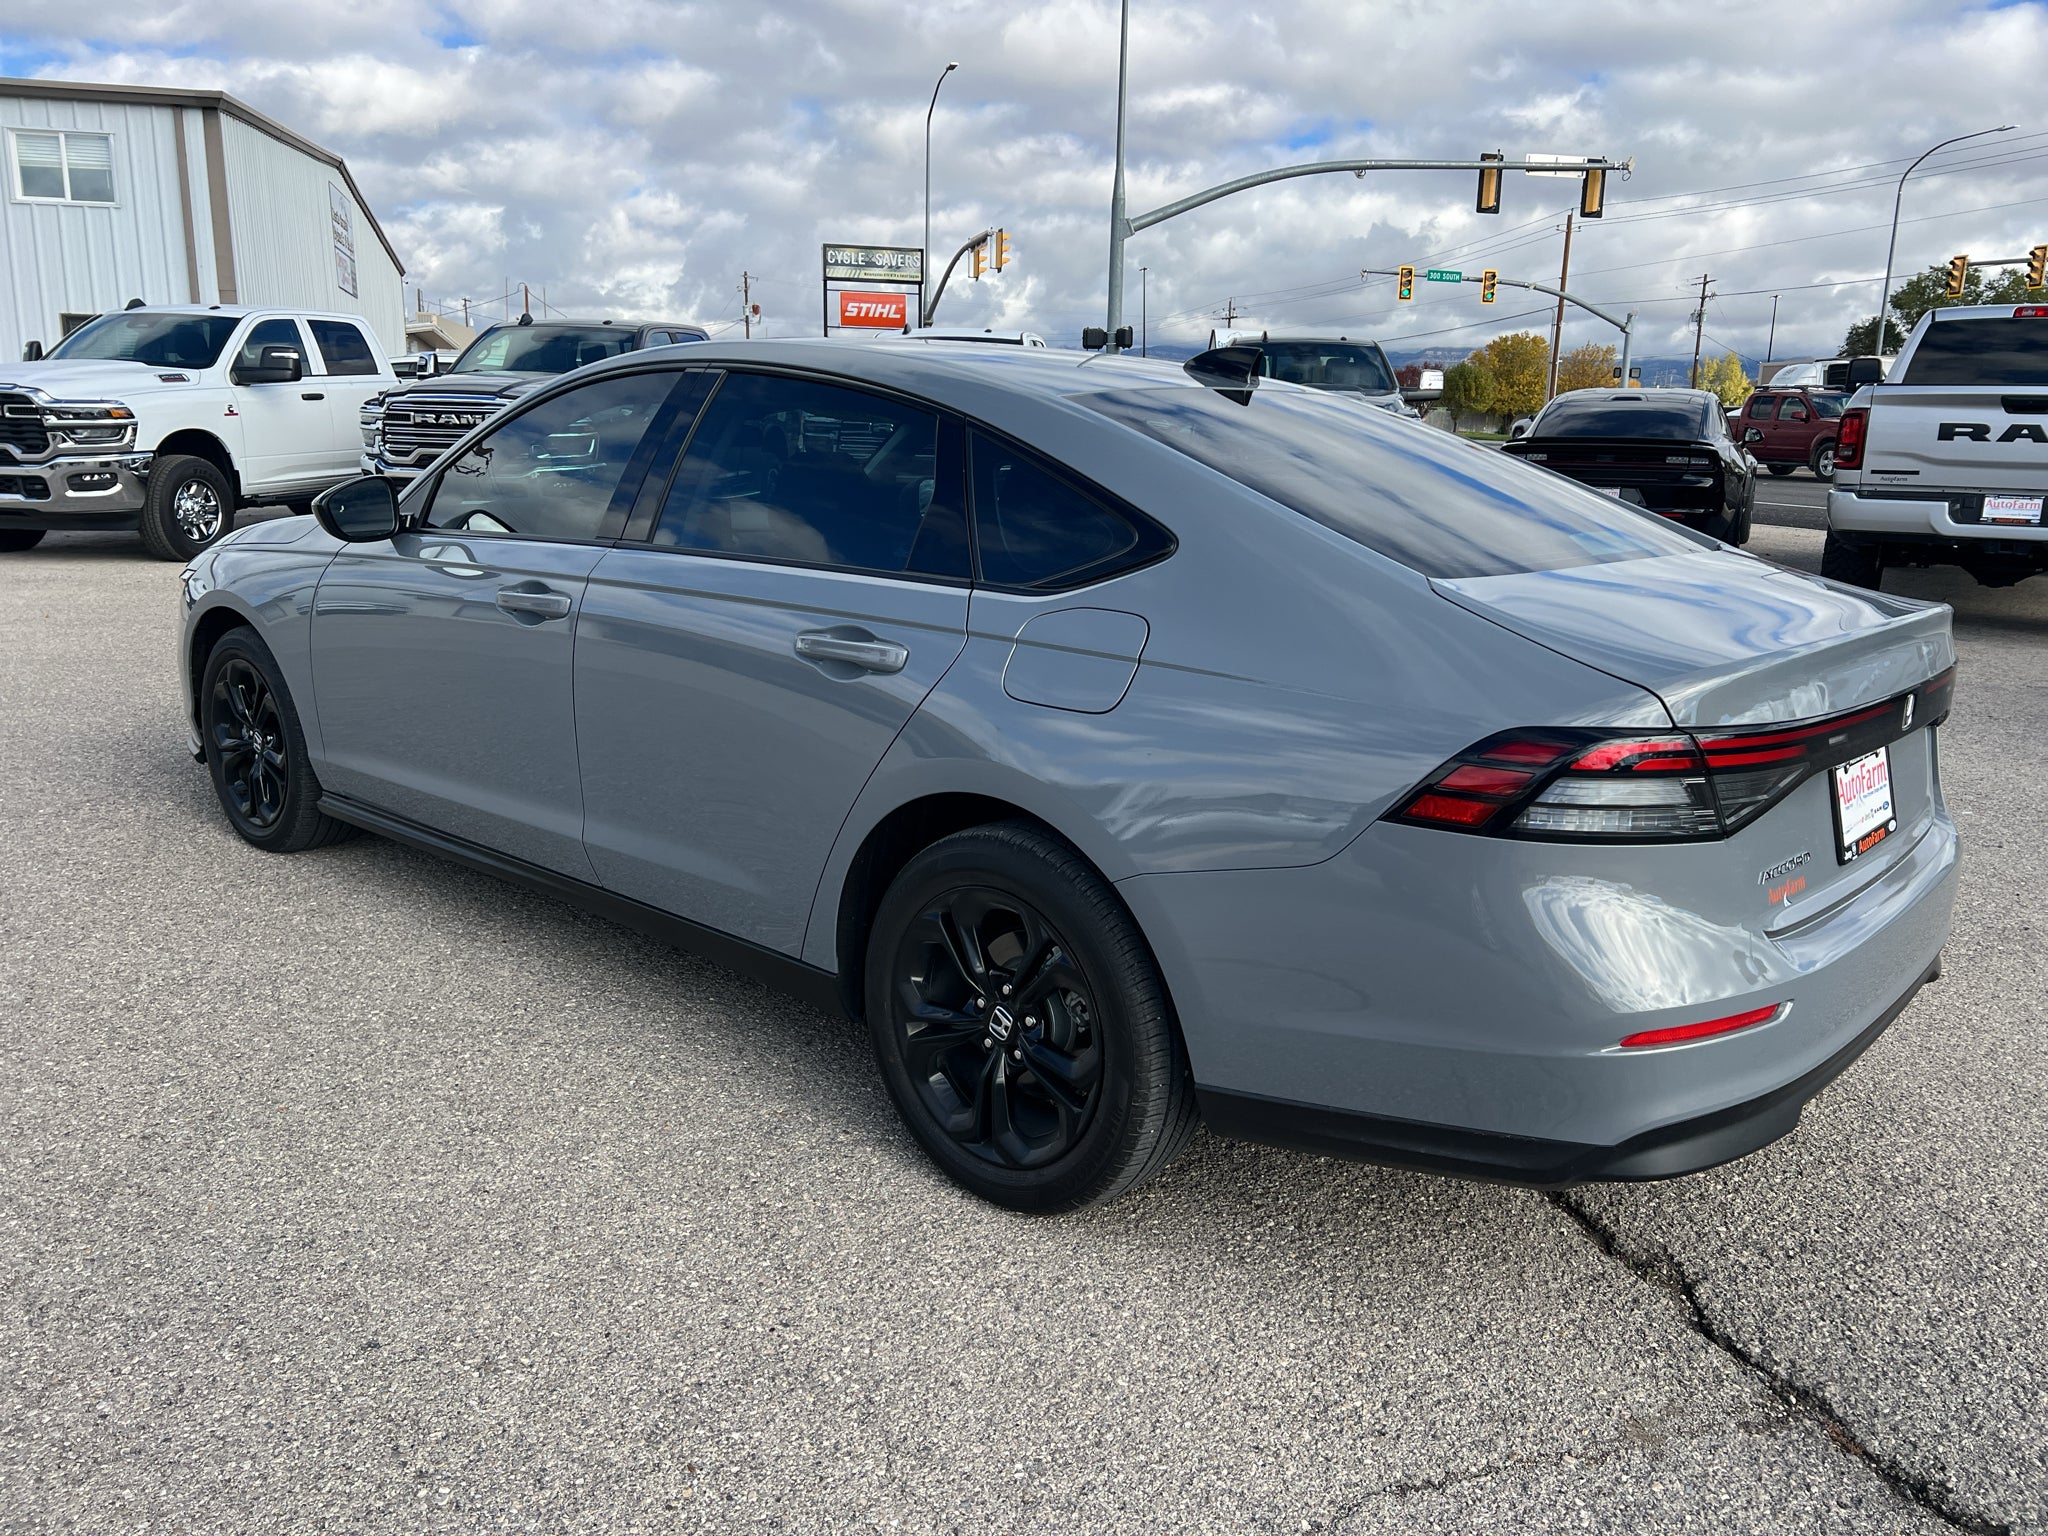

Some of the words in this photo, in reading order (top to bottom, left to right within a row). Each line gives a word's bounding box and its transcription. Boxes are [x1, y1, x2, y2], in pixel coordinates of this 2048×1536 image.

[827, 250, 866, 265] CYCLE
[875, 253, 920, 269] SAVERS
[1430, 272, 1440, 280] 300
[1442, 273, 1460, 281] SOUTH
[845, 302, 901, 319] STIHL
[414, 413, 483, 425] RAM
[1985, 499, 2041, 509] AutoFarm
[1838, 763, 1888, 805] AutoFarm
[1858, 828, 1886, 854] AutoFarm
[1758, 851, 1811, 885] ACCORD
